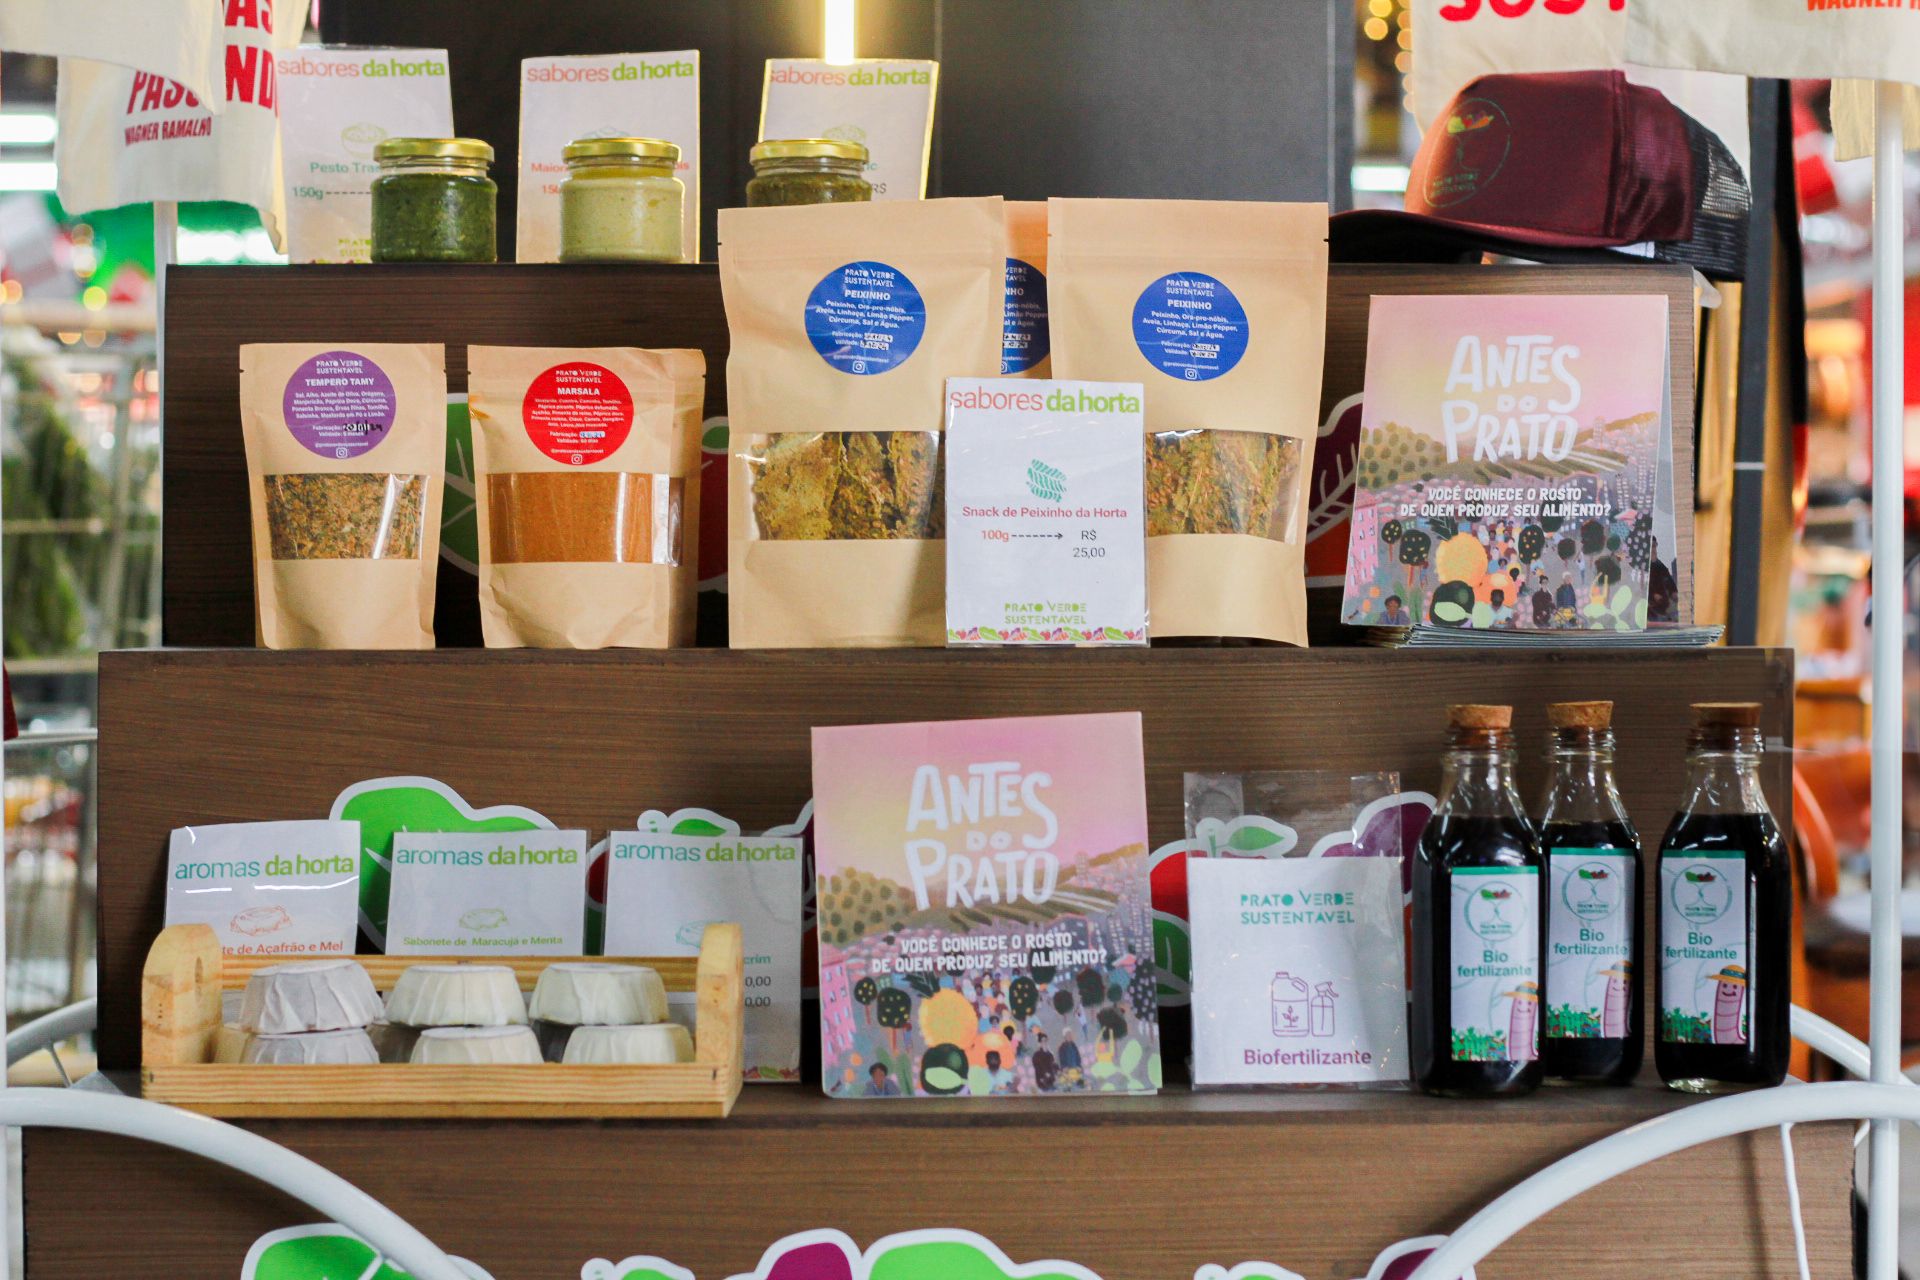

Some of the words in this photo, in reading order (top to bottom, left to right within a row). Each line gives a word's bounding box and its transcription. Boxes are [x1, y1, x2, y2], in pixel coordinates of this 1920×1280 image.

[278, 58, 359, 78] sabores
[391, 58, 445, 76] horta
[527, 65, 609, 82] sabores
[641, 61, 693, 78] horta
[876, 68, 930, 85] horta
[125, 123, 158, 146] WAGNER
[162, 117, 212, 140] RAMALHO
[310, 162, 349, 173] Pesto
[294, 186, 324, 199] 150g
[845, 269, 869, 277] PRATO
[870, 269, 895, 279] VERDE
[844, 277, 894, 287] SUSTENTAVEL
[1166, 279, 1190, 288] PRATO
[1191, 280, 1215, 290] VERDE
[844, 289, 891, 301] PEIXINHO
[1166, 287, 1214, 297] SUSTENTAVEL
[1168, 299, 1212, 310] PEIXINHO
[340, 359, 363, 367] VERDE
[1444, 334, 1582, 414] ANTES
[305, 378, 348, 386] TEMPERO
[349, 377, 374, 386] TAMY
[557, 387, 600, 395] MARSALA
[950, 386, 1043, 411] sabores
[1046, 388, 1075, 412] da
[1079, 389, 1140, 413] horta
[1498, 394, 1538, 412] DO
[1441, 400, 1579, 464] PRATO
[1428, 485, 1461, 501] VOCÊ
[1464, 488, 1523, 501] CONHECE
[1527, 487, 1536, 501] O
[1539, 487, 1582, 501] ROSTO
[962, 506, 1000, 518] Snack
[1002, 506, 1017, 518] de
[1020, 506, 1073, 518] Peixinho
[1075, 506, 1090, 518] da
[1093, 506, 1128, 518] Horta
[1400, 504, 1417, 517] DE
[1421, 504, 1454, 517] QUEM
[1458, 504, 1508, 517] PRODUZ
[1513, 504, 1539, 517] SEU
[1542, 504, 1611, 517] ALIMENTO?
[982, 530, 1009, 542] 100g
[1081, 529, 1097, 541] R$
[1073, 547, 1106, 559] 25,00
[1004, 602, 1044, 612] PRATO
[1047, 600, 1087, 612] VERDE
[1005, 615, 1087, 625] SUSTENTAVEL
[905, 761, 1058, 849] ANTES
[966, 831, 1012, 851] DO
[396, 849, 484, 865] aromas
[488, 846, 516, 865] da
[519, 845, 578, 865] horta
[614, 842, 701, 862] aromas
[705, 842, 734, 862] da
[737, 842, 795, 861] horta
[175, 860, 260, 879] aromas
[265, 854, 293, 877] da
[297, 854, 354, 876] horta
[905, 838, 1059, 911] PRATO
[1240, 894, 1294, 907] PRATO
[1299, 890, 1354, 906] VERDE
[1241, 911, 1355, 925] SUSTENTAVEL
[404, 937, 451, 946] Sabonete
[454, 937, 467, 946] de
[530, 936, 563, 945] Menta
[1579, 929, 1604, 942] Bio
[1688, 932, 1713, 945] Bio
[237, 944, 252, 954] de
[256, 942, 305, 954] Açafrão
[320, 940, 343, 951] Mel
[901, 935, 938, 953] VOCÊ
[942, 935, 1007, 951] CONHECE
[1012, 935, 1022, 950] O
[1026, 933, 1072, 949] ROSTO
[1553, 943, 1628, 955] fertilizante
[1483, 950, 1508, 963] Bio
[1665, 946, 1737, 960] fertilizante
[872, 958, 890, 973] DE
[895, 957, 933, 973] QUEM
[937, 955, 994, 970] PRODUZ
[999, 954, 1028, 969] SEU
[1031, 950, 1107, 967] ALIMENTO?
[1457, 965, 1532, 977] fertilizante
[1244, 1049, 1372, 1065] Biofertilizante
